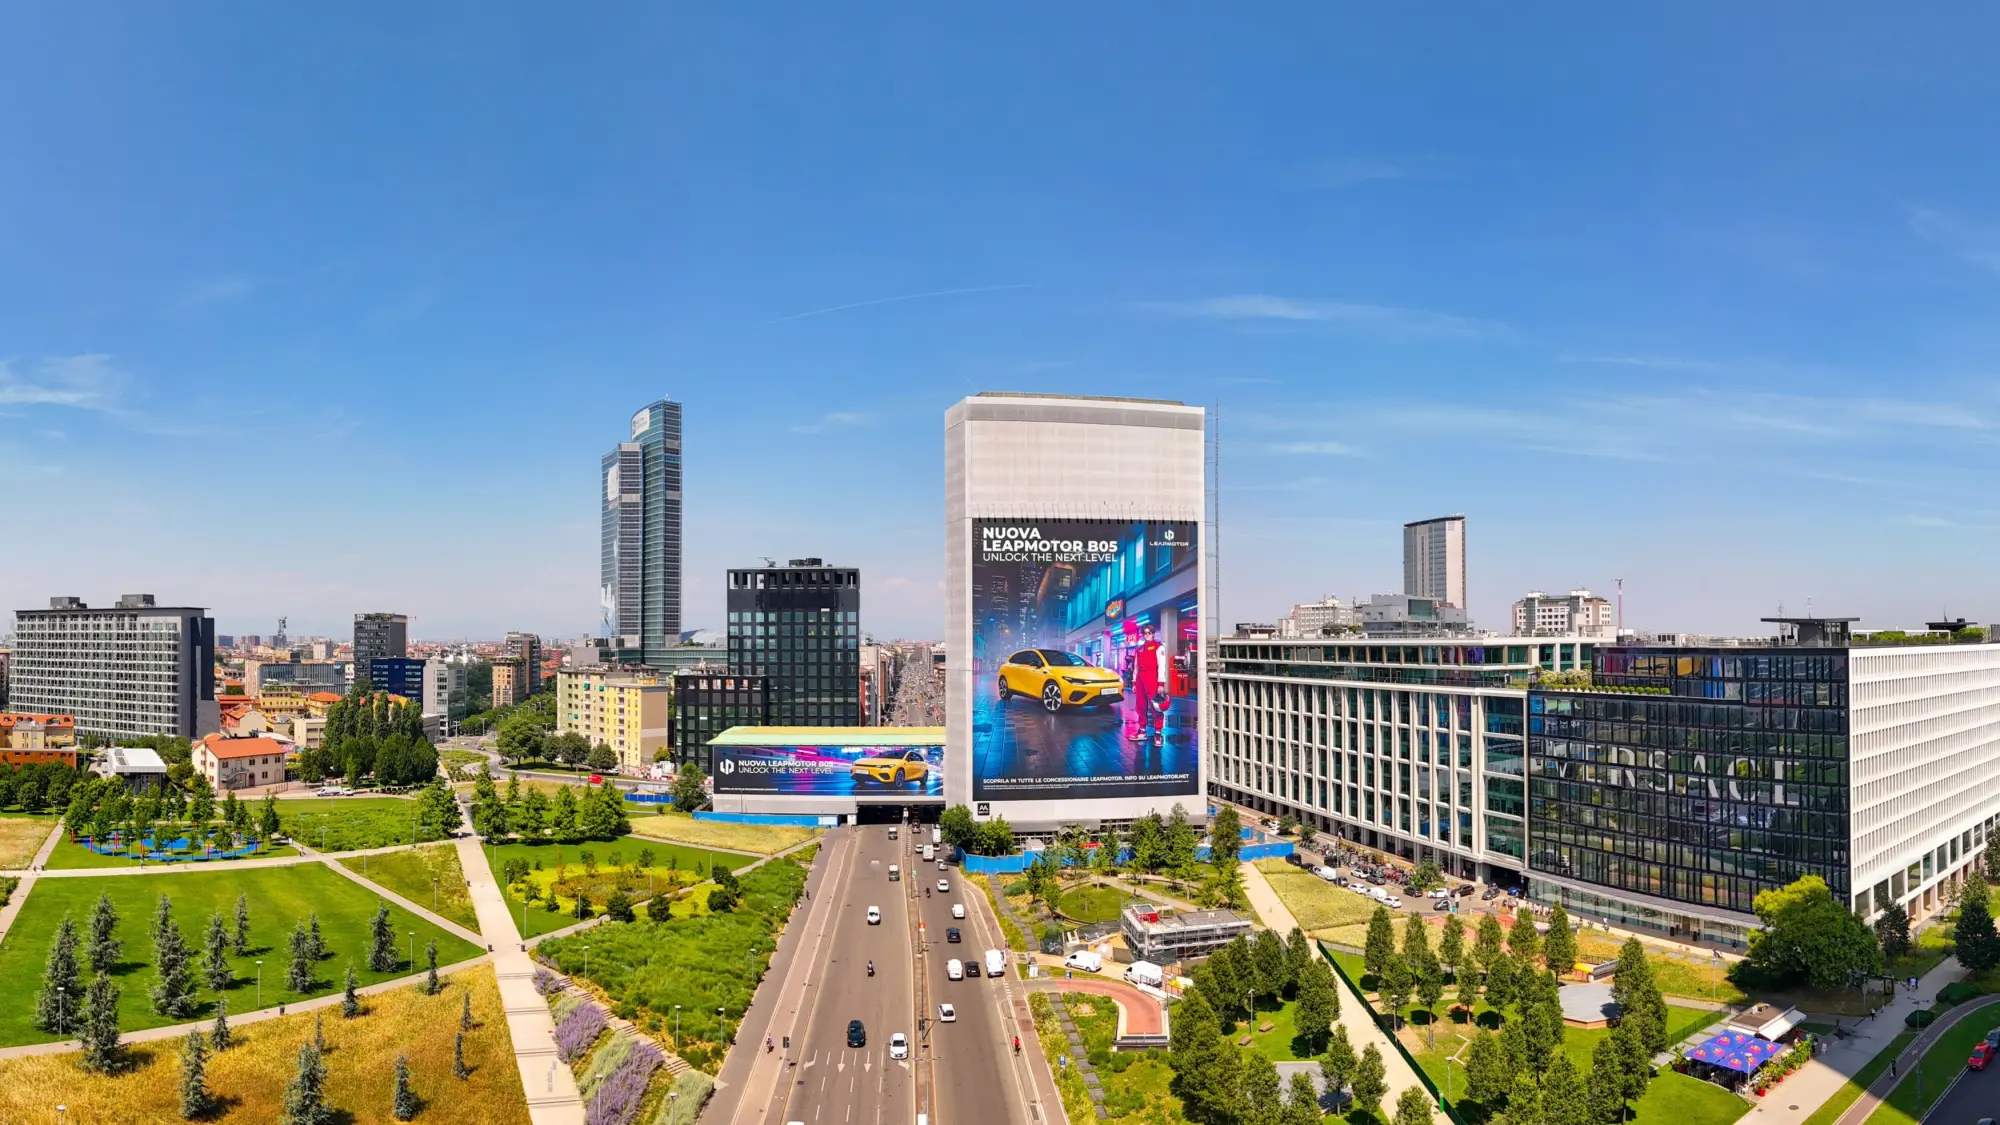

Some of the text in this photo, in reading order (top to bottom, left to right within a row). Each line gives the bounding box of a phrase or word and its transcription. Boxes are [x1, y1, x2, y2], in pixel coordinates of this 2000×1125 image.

[983, 527, 1041, 539] NUOVA
[983, 540, 1118, 552] LEAPMOTOR B05
[983, 552, 1117, 562] UNLOCK THE NEXT LEVEL
[818, 760, 834, 768] B05
[811, 767, 834, 775] LEVEL
[1548, 740, 1800, 806] VERSACE
